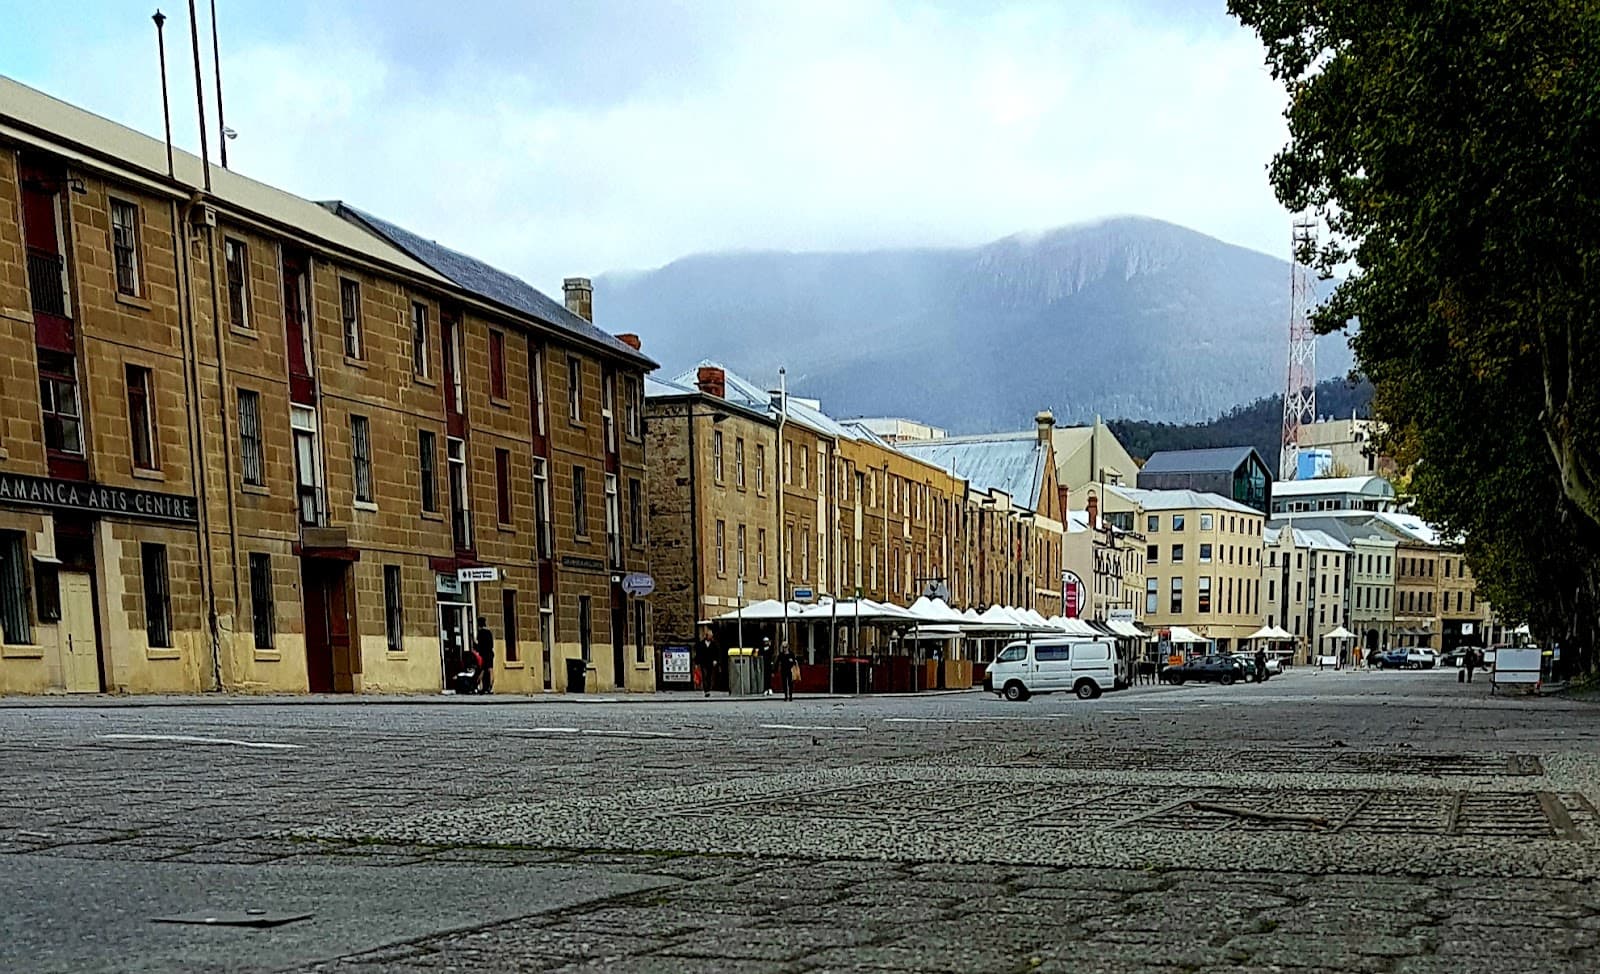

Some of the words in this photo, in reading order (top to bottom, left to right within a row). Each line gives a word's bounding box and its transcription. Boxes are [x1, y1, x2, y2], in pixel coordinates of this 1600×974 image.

[0, 477, 80, 504] AMANCA
[88, 487, 127, 510] ARTS
[135, 494, 190, 517] CENTRE
